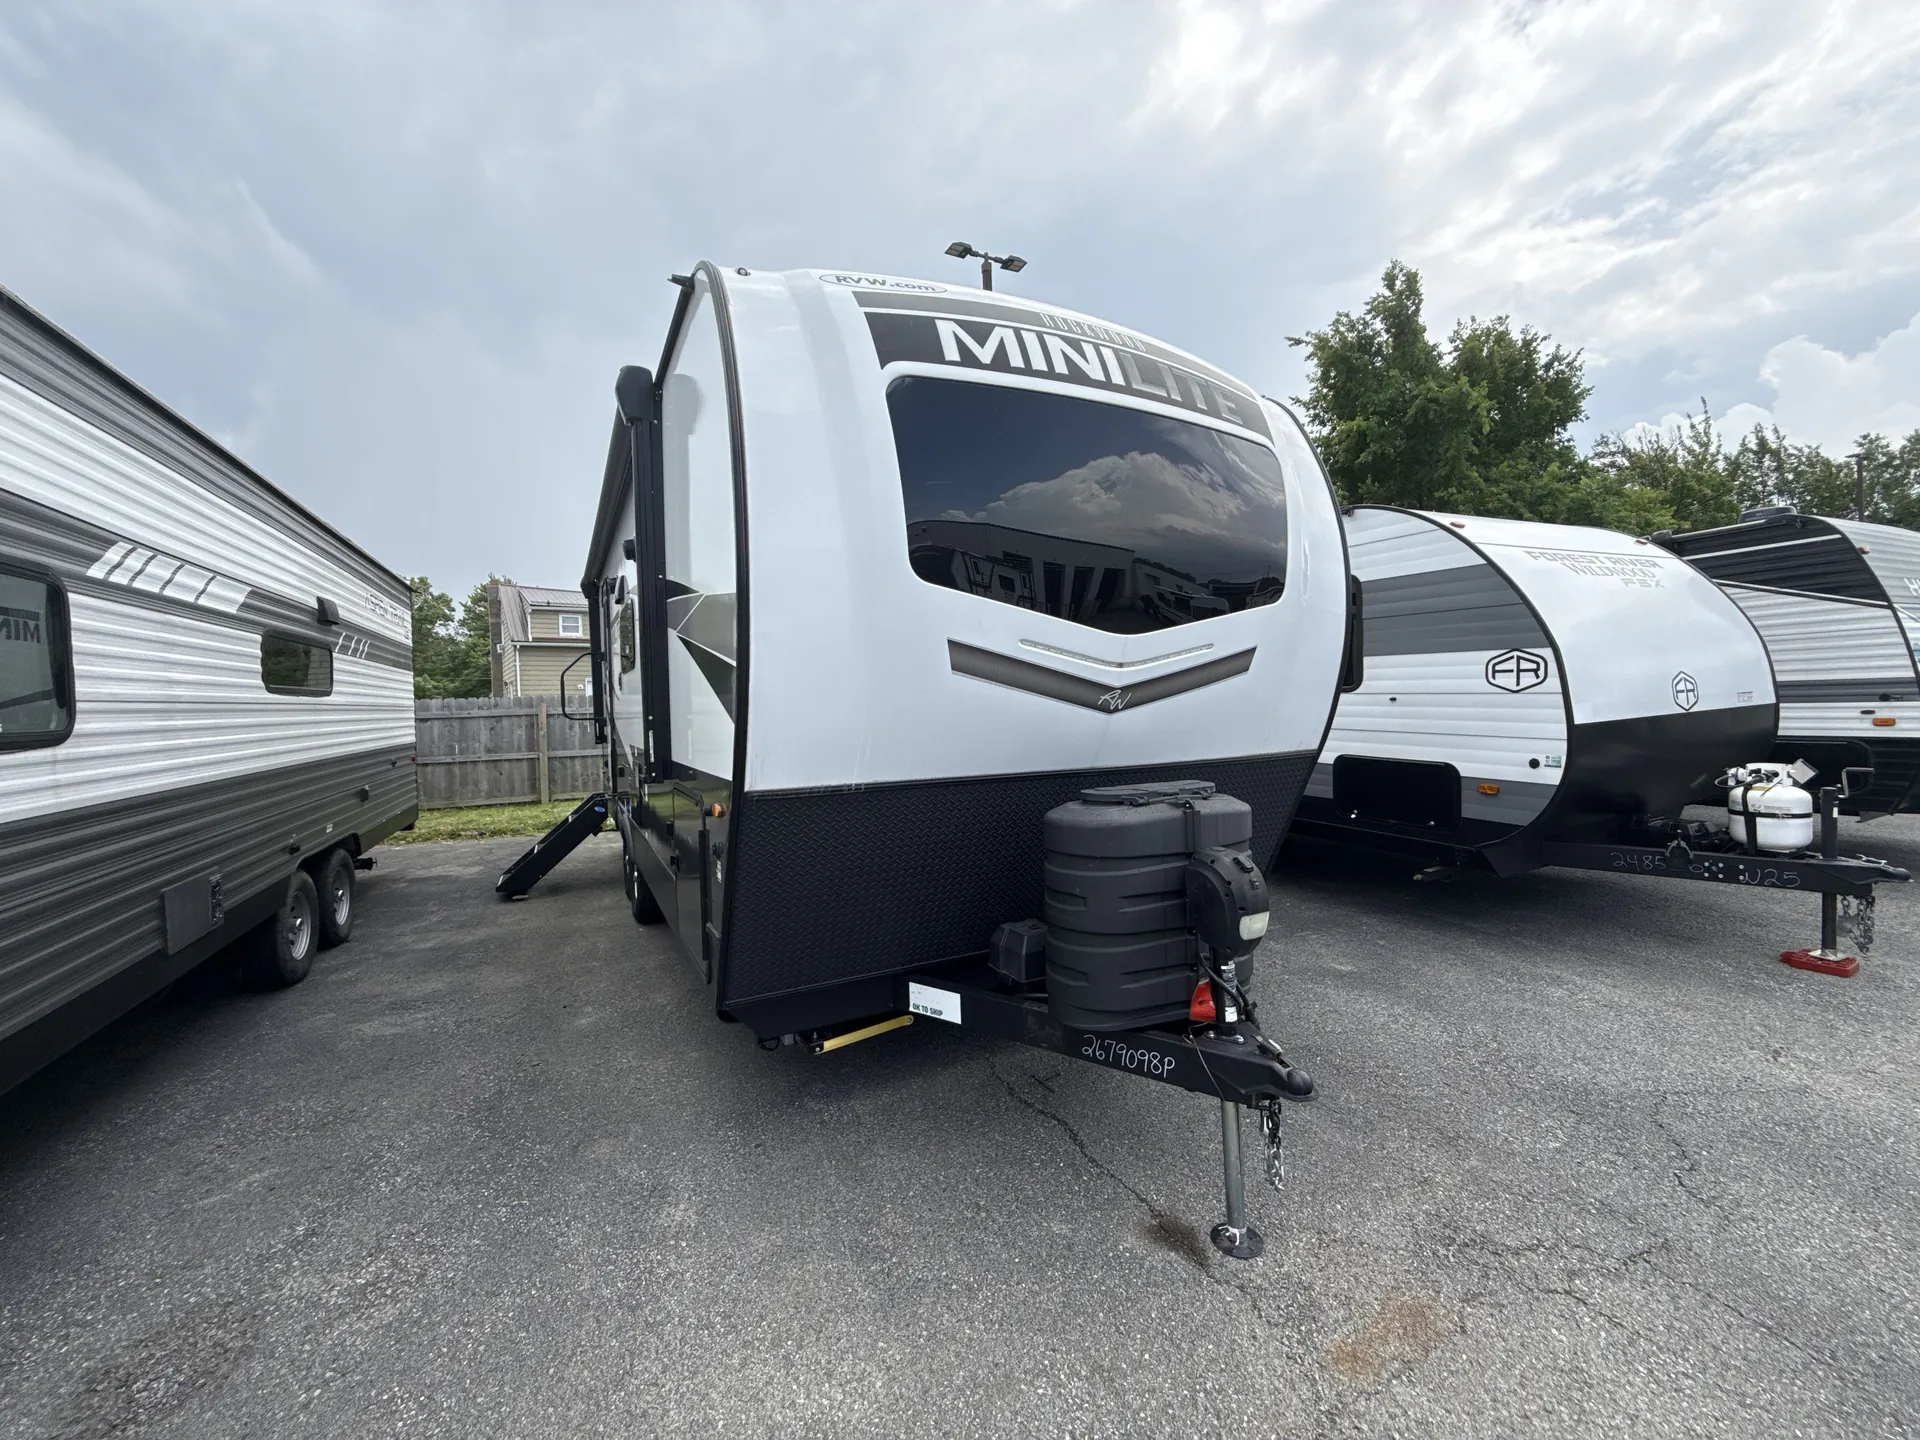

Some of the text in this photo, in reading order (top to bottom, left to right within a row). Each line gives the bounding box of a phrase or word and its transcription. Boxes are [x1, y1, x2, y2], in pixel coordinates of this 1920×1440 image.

[835, 275, 936, 292] RVW.com
[1523, 550, 1664, 569] FOREST RIVER
[1560, 562, 1656, 579] WILDWOOD
[1491, 654, 1542, 688] FR
[1674, 675, 1697, 706] FR
[920, 1004, 929, 1014] TO
[1081, 1034, 1176, 1079] 2679098P
